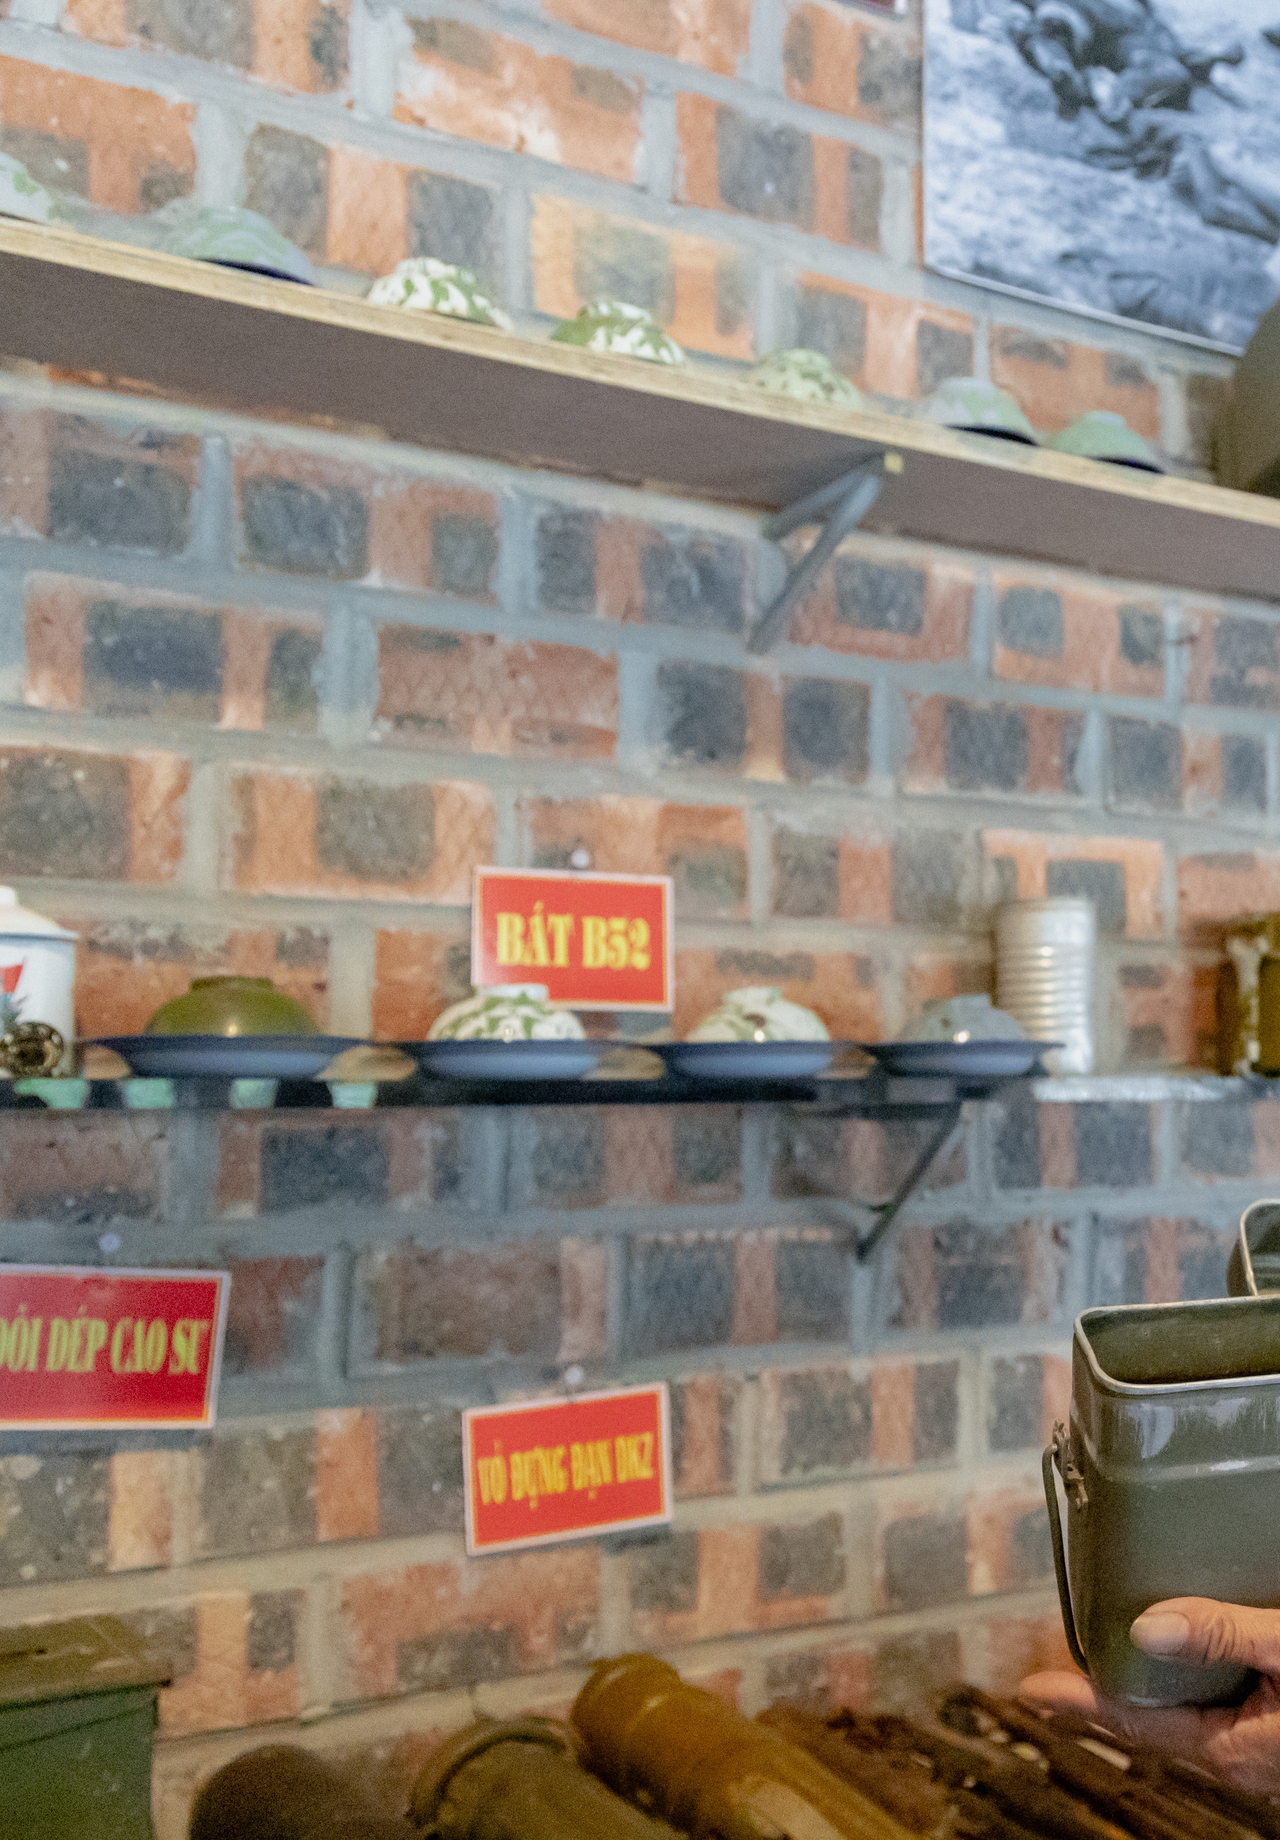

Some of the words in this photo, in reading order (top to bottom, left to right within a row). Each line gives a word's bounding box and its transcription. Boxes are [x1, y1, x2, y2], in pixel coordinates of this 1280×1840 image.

[496, 901, 574, 968] BÁT
[582, 916, 650, 970] B52
[110, 1316, 168, 1374] CAO
